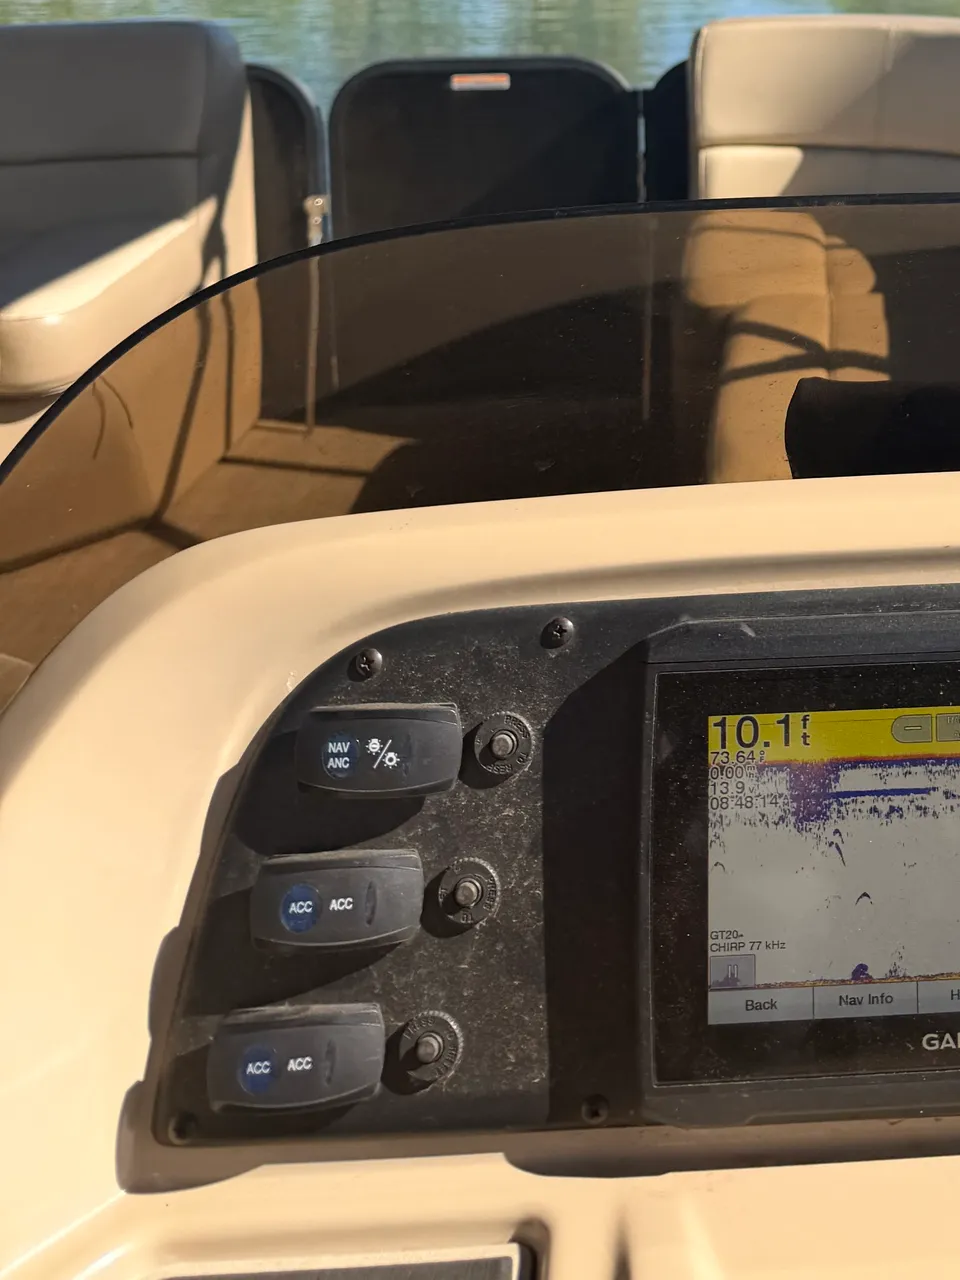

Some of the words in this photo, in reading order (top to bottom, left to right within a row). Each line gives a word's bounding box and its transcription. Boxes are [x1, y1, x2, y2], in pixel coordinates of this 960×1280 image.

[713, 714, 791, 750] 10.1
[328, 742, 350, 753] NAV
[327, 757, 350, 769] ANC
[710, 750, 756, 765] 73.64
[710, 765, 744, 780] 0.00
[711, 781, 745, 795] 13.9
[710, 795, 779, 810] 08:48:14
[289, 901, 313, 914] ACC
[329, 897, 353, 911] ACC
[710, 942, 745, 952] CHIRP
[749, 941, 762, 950] 77
[765, 941, 786, 950] kHz
[745, 999, 778, 1011] Back
[838, 995, 863, 1006] Nav
[868, 993, 894, 1004] Info
[246, 1061, 271, 1074] ACC
[287, 1056, 313, 1071] ACC
